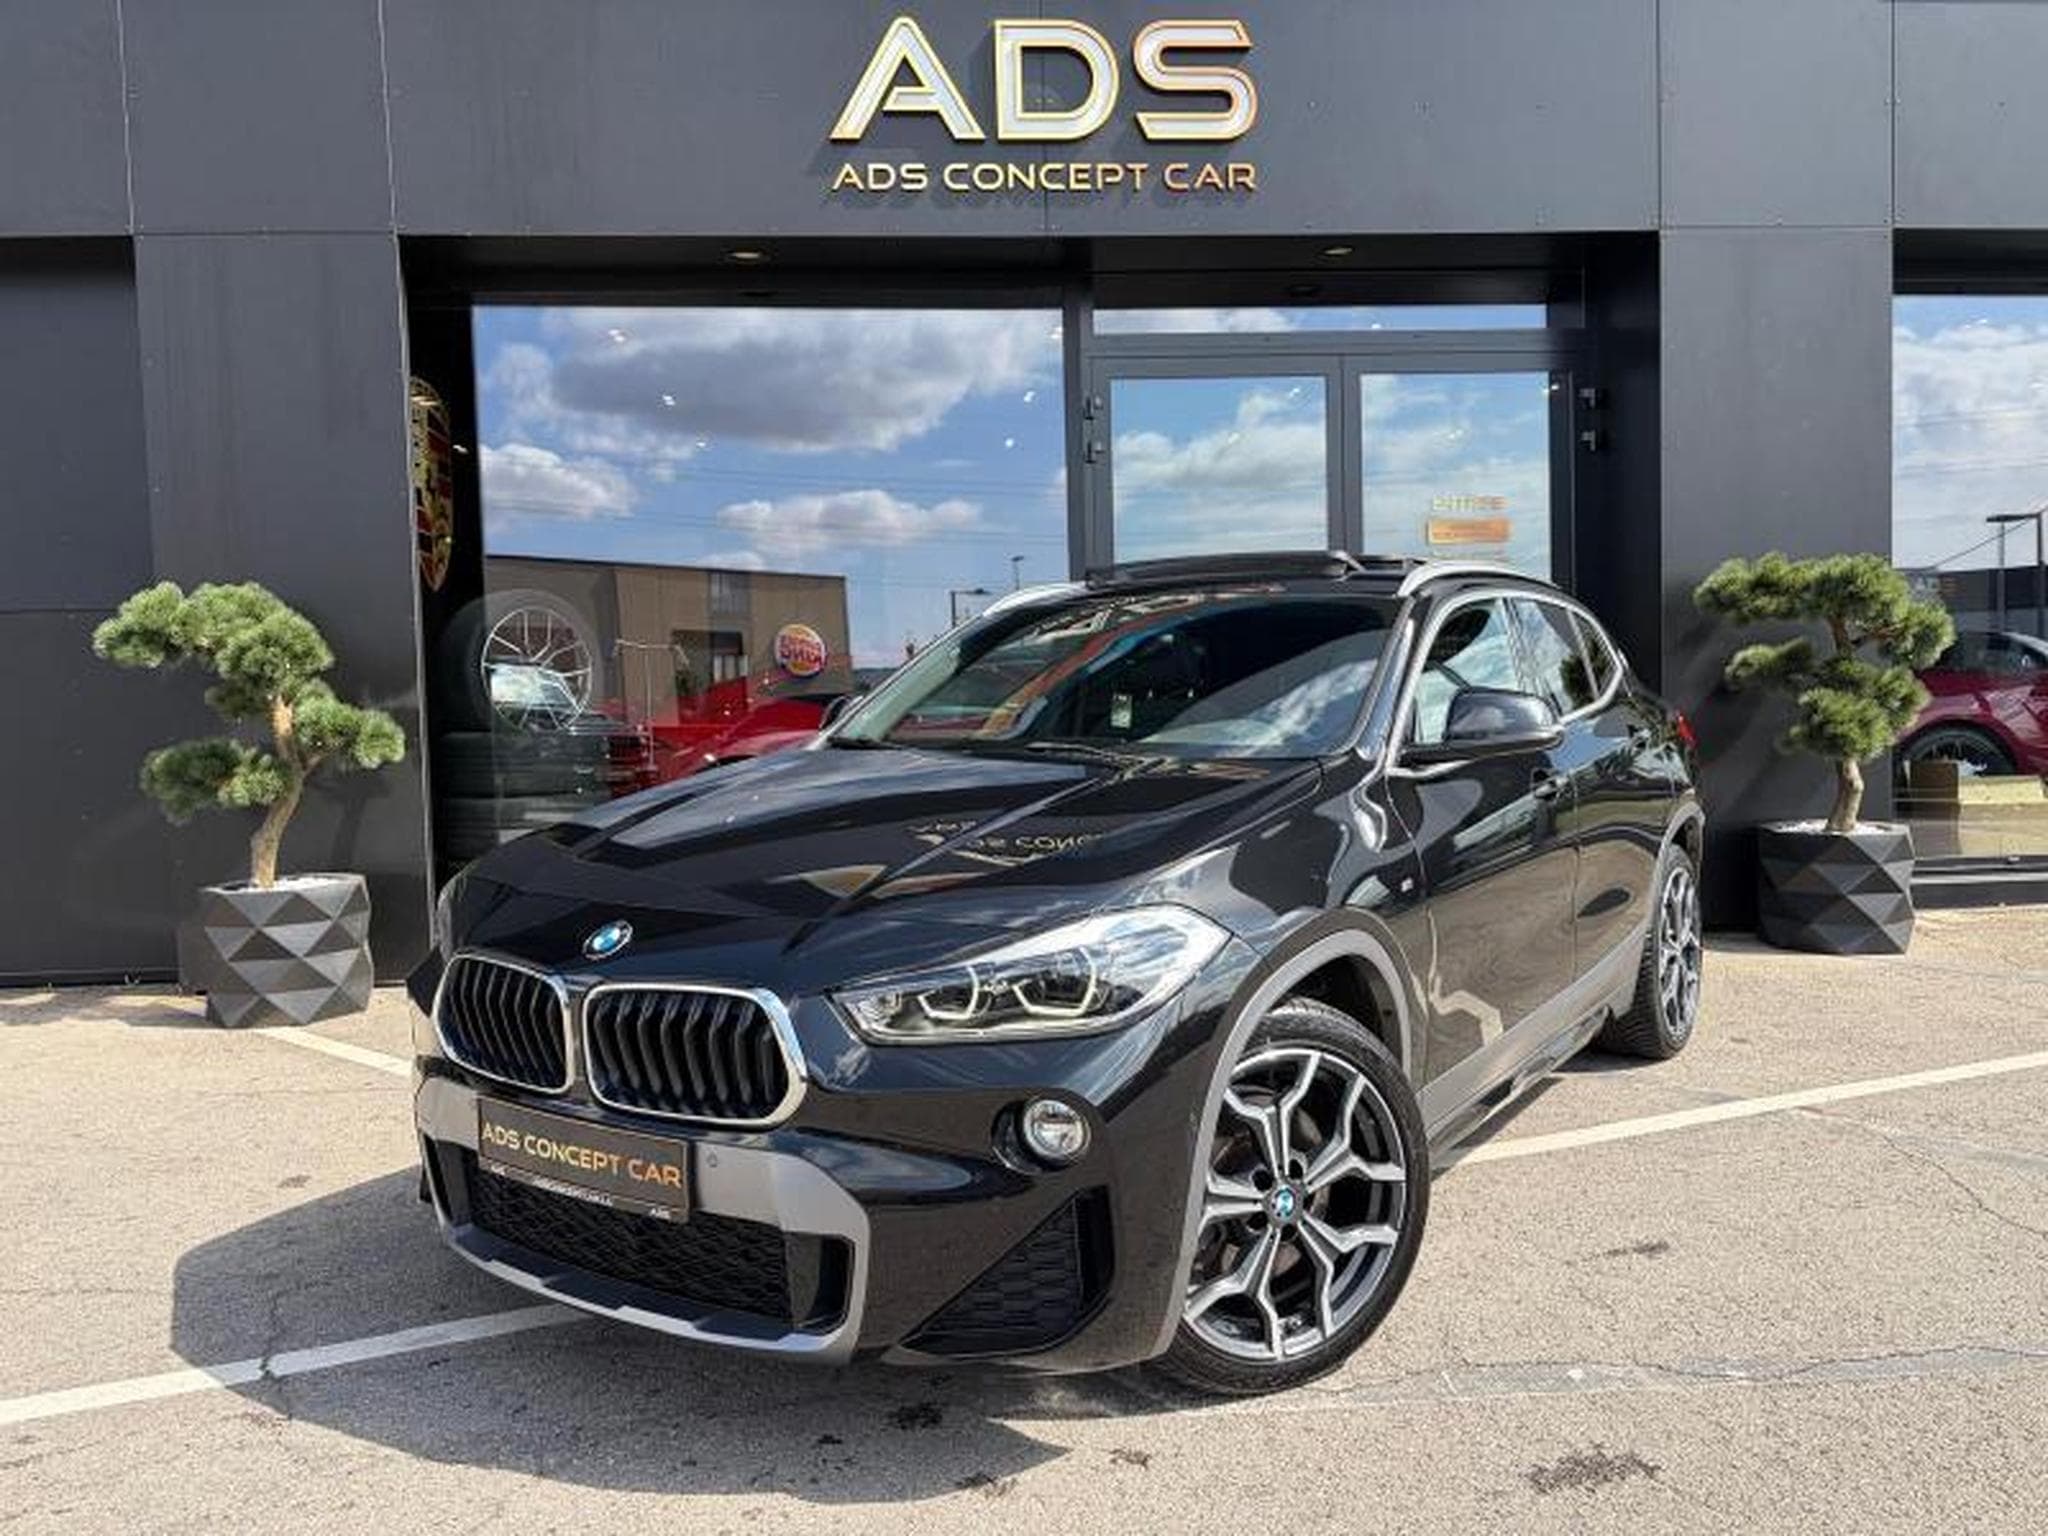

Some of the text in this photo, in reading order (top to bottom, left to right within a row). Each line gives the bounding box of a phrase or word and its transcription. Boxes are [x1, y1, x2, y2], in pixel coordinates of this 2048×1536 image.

[829, 16, 1258, 141] ADS
[832, 162, 1257, 191] ADS CONCEPT CAR
[481, 1122, 521, 1151] ADS
[523, 1134, 621, 1176] CONCEPT
[628, 1158, 682, 1189] CAR
